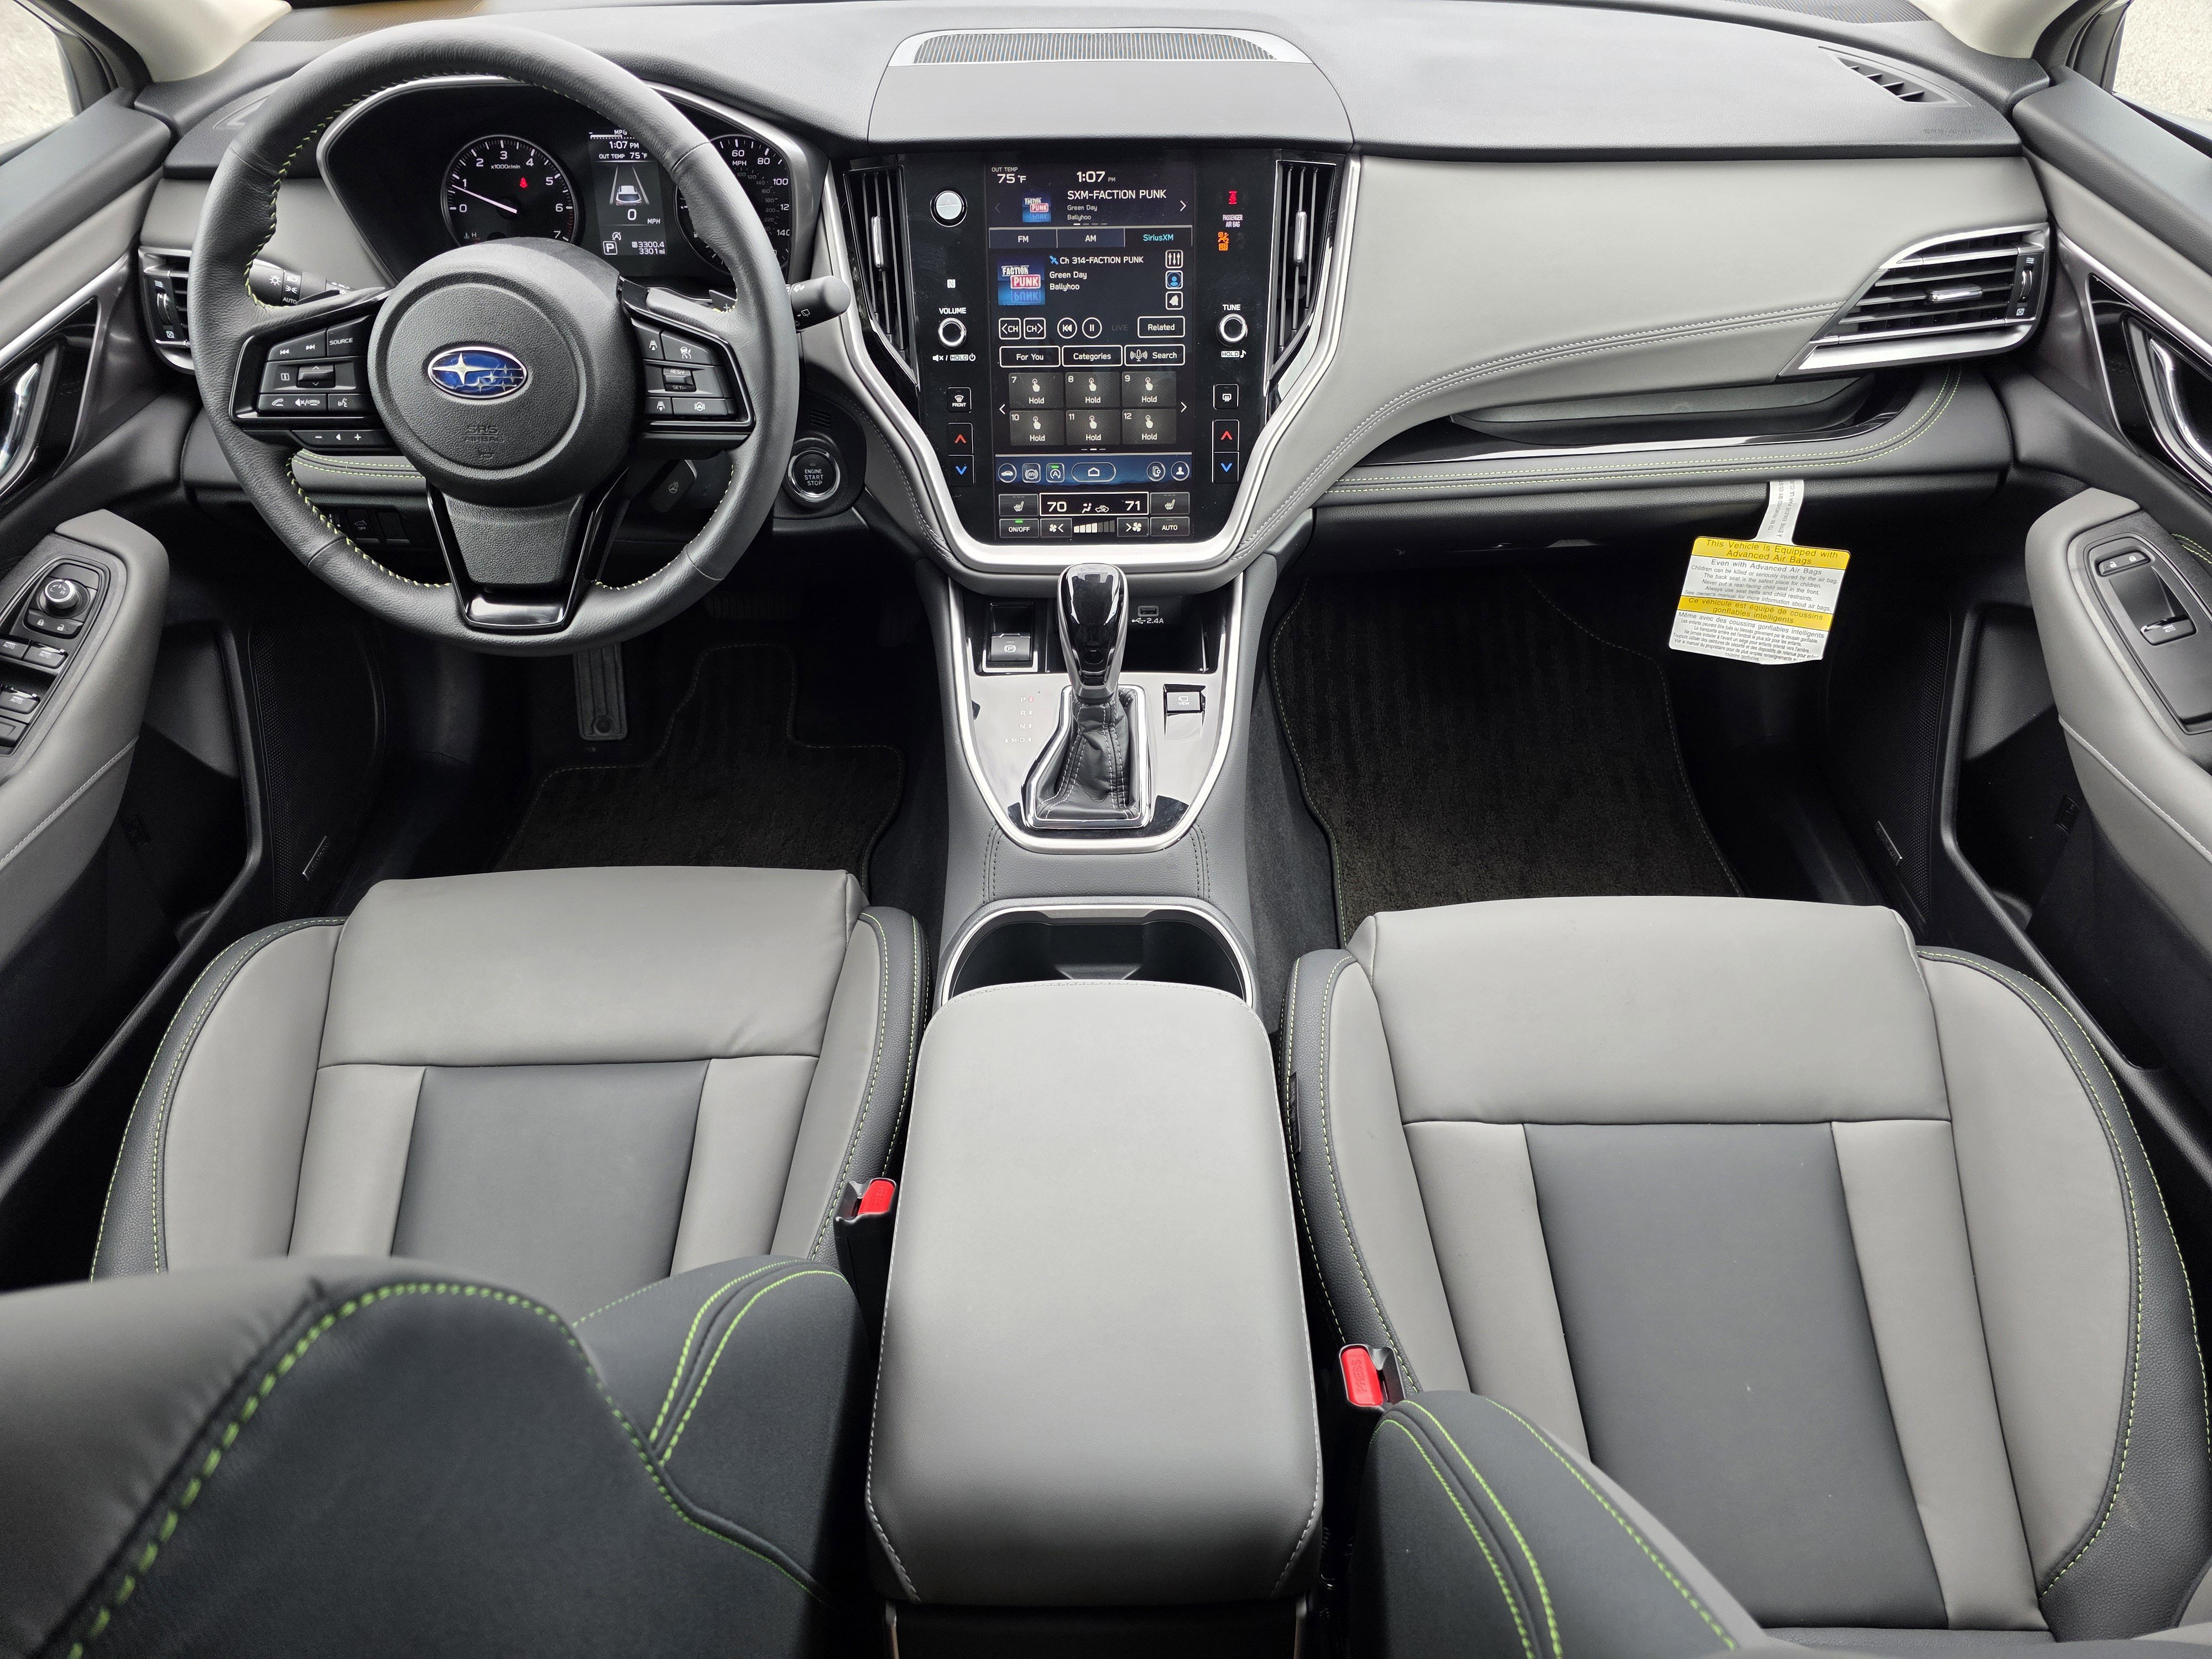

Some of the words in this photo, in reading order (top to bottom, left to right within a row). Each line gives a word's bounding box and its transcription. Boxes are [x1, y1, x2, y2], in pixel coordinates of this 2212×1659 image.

[500, 151, 507, 159] 3
[476, 158, 483, 166] 2
[526, 158, 534, 166] 4
[546, 177, 553, 185] 5
[998, 174, 1015, 184] 75
[1077, 171, 1105, 182] 1:07
[1068, 190, 1135, 200] SXM-FACTION
[1140, 190, 1167, 199] PUNK
[459, 204, 467, 212] 0
[556, 204, 563, 212] 6
[628, 209, 637, 221] 0
[606, 243, 614, 252] P
[1002, 267, 1029, 275] FACTION
[1014, 276, 1039, 287] PUNK
[466, 425, 499, 435] SRS
[1047, 502, 1067, 512] 70
[1125, 501, 1140, 511] 71
[1772, 500, 1782, 518] REMOVED
[1728, 541, 1759, 550] Vehicle
[1775, 546, 1816, 557] Equipped
[1726, 550, 1769, 560] Advanced
[1790, 556, 1811, 565] Bags
[1750, 563, 1786, 572] Advanced
[1702, 598, 1731, 607] véhicule
[1749, 604, 1774, 613] équipé
[1790, 611, 1823, 619] coussins
[1713, 606, 1750, 617] gonflables
[1754, 612, 1793, 624] intelligents
[1757, 623, 1788, 633] gonflables
[1791, 629, 1824, 639] intelligents
[1352, 1359, 1367, 1391] PRESS
